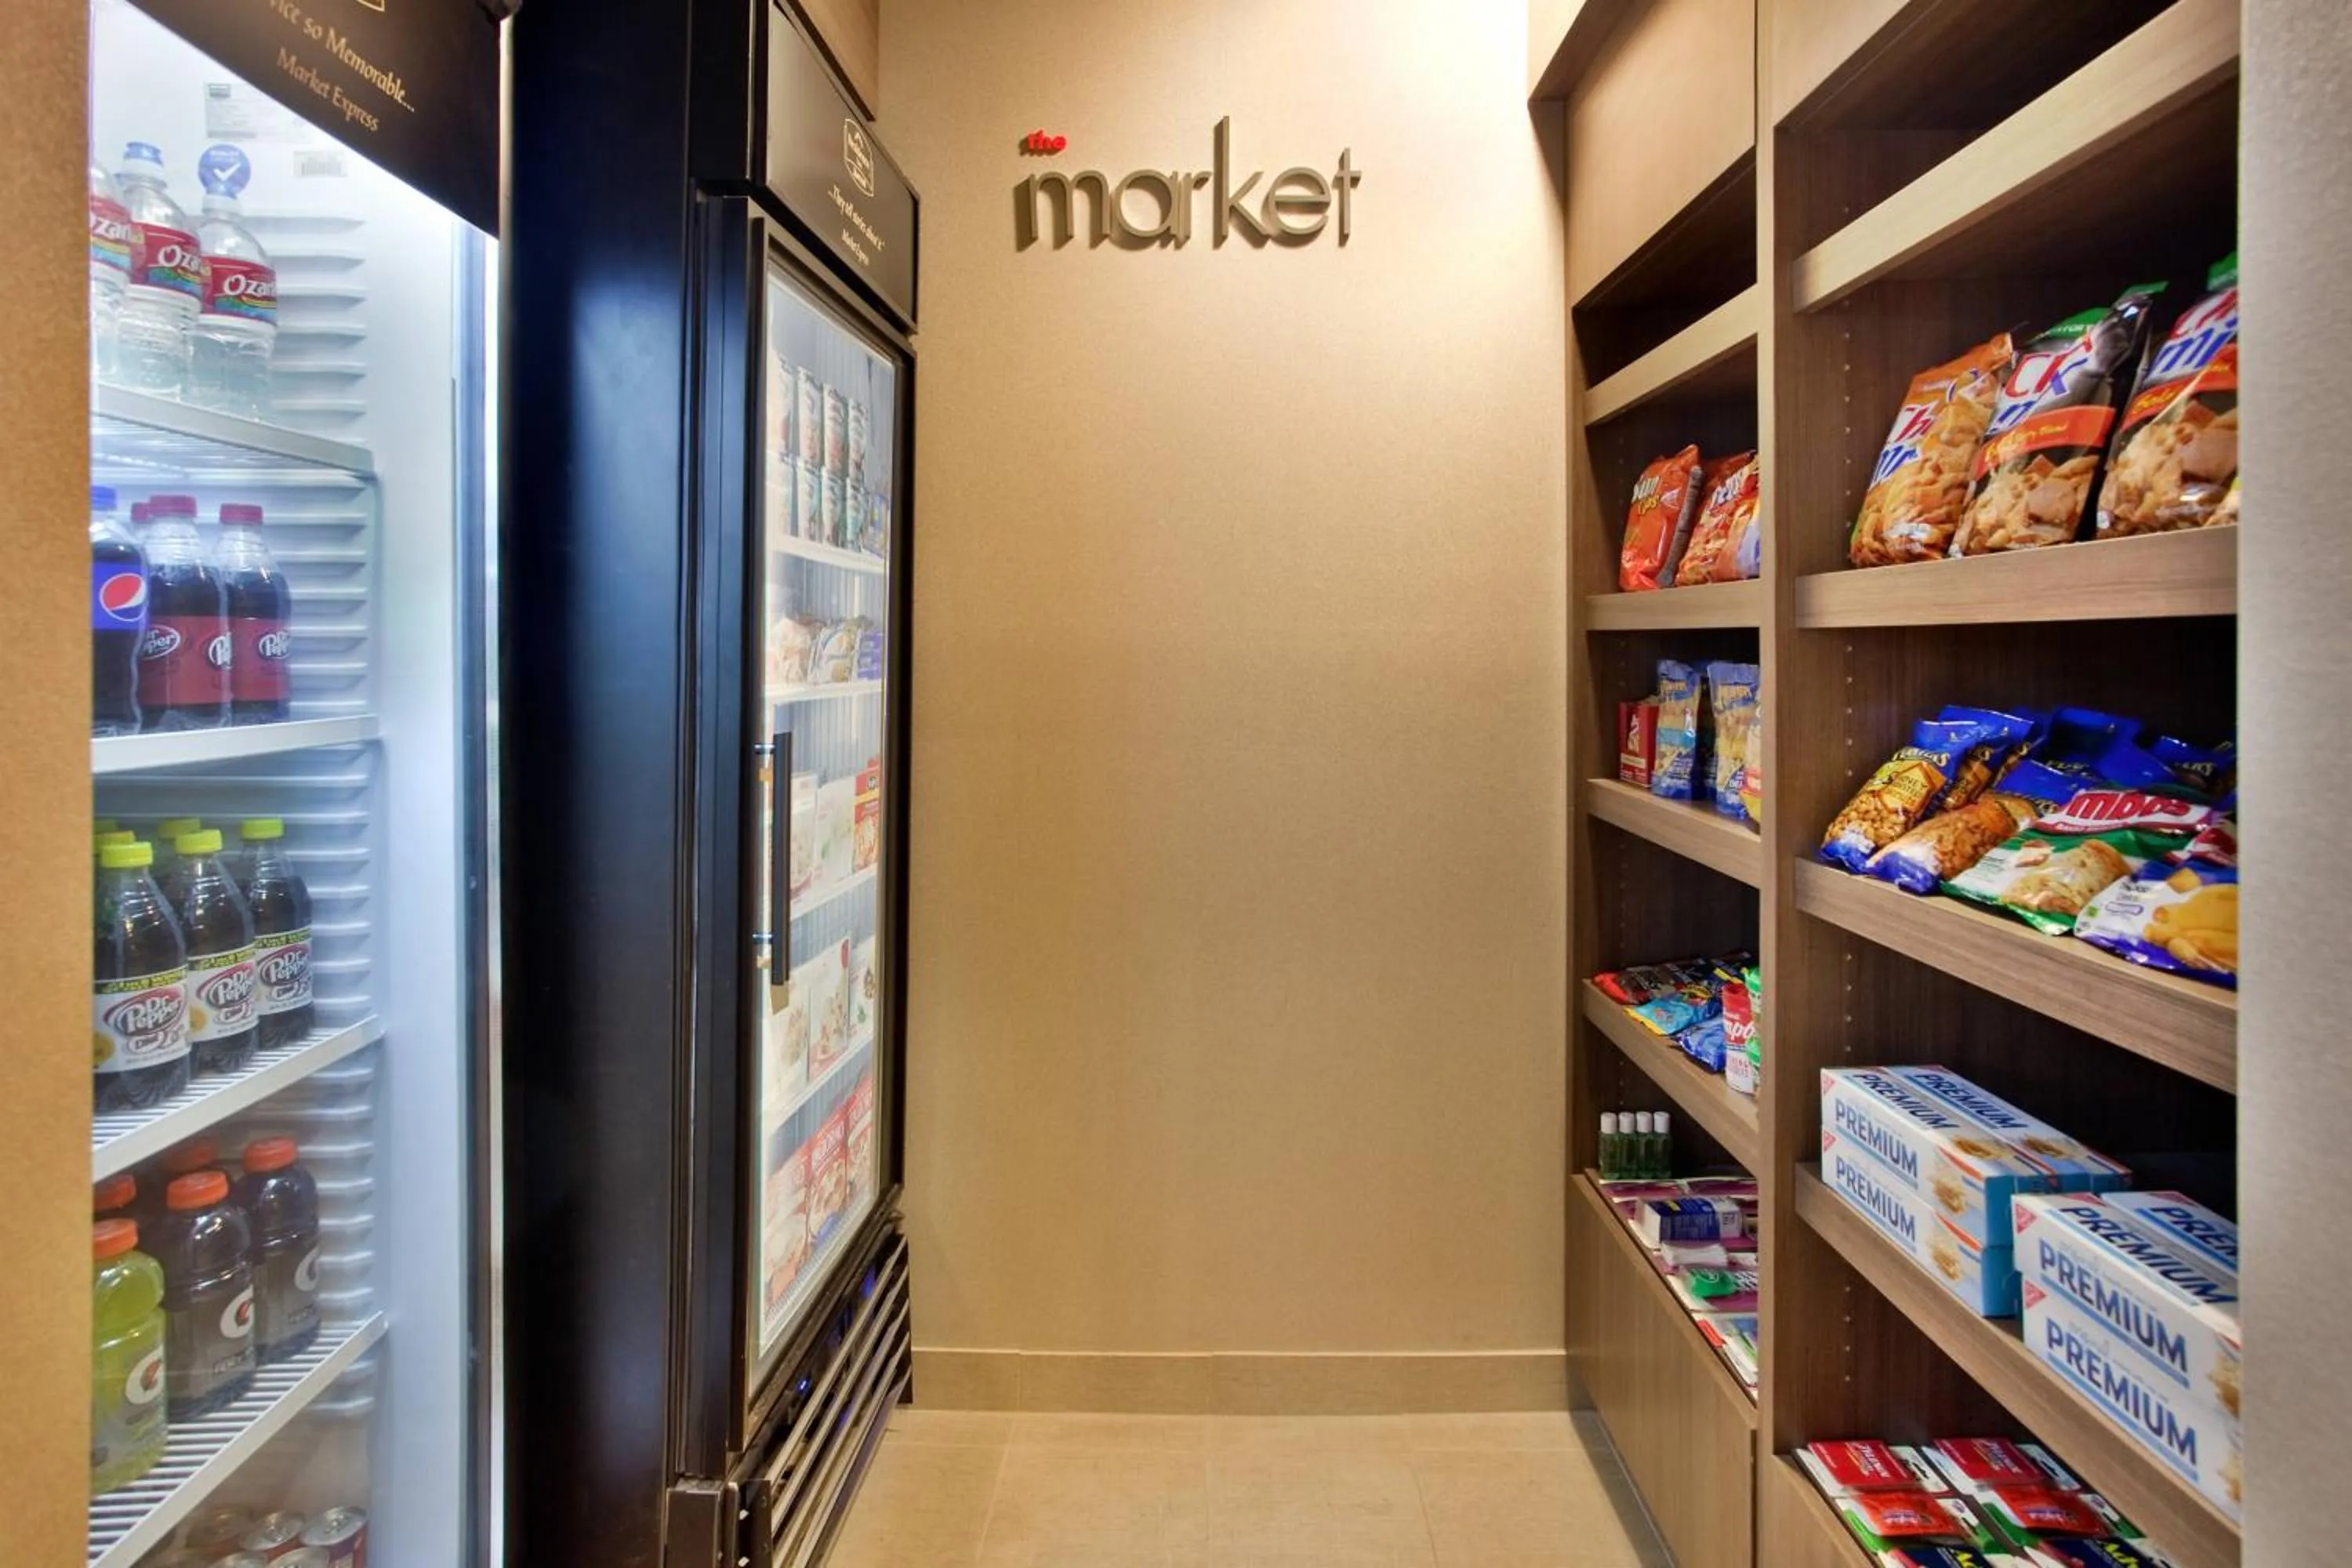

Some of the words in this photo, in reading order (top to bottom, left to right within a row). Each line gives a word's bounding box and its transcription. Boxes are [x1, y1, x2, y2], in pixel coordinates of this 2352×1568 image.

[303, 17, 322, 38] so
[277, 46, 330, 98] Market
[332, 86, 379, 131] Express
[1019, 115, 1362, 245] market
[1025, 129, 1067, 152] the
[126, 1001, 180, 1033] Pepper
[1835, 1098, 1918, 1178] PREMIUM
[1853, 1074, 1958, 1129] PREMIUM
[1915, 1074, 2028, 1128] PREMIUM
[1835, 1155, 1915, 1243] PREMIUM
[2060, 1207, 2238, 1304] PREMIUM
[2039, 1239, 2188, 1372] PREMIUM
[2046, 1317, 2198, 1465] PREMIUM
